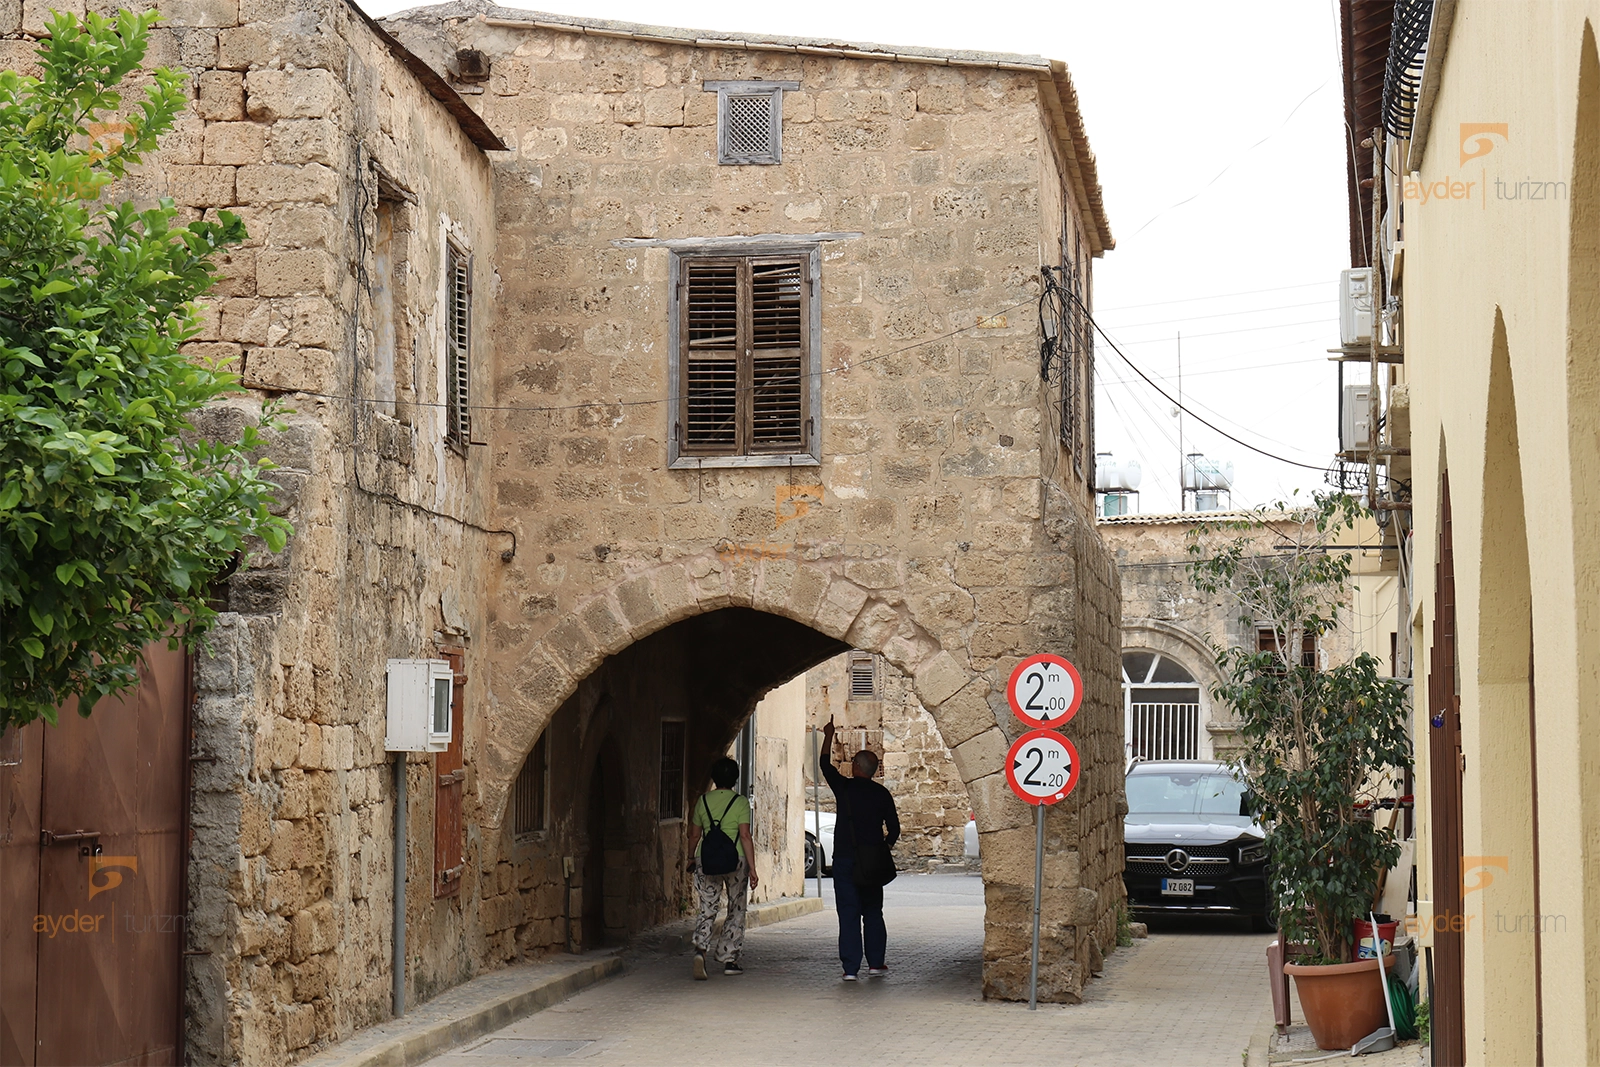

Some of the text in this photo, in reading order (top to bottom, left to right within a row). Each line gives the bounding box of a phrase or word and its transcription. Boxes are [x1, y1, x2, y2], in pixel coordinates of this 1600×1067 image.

[1048, 673, 1060, 683] m
[1047, 749, 1059, 759] m
[1168, 882, 1193, 892] YZ 082
